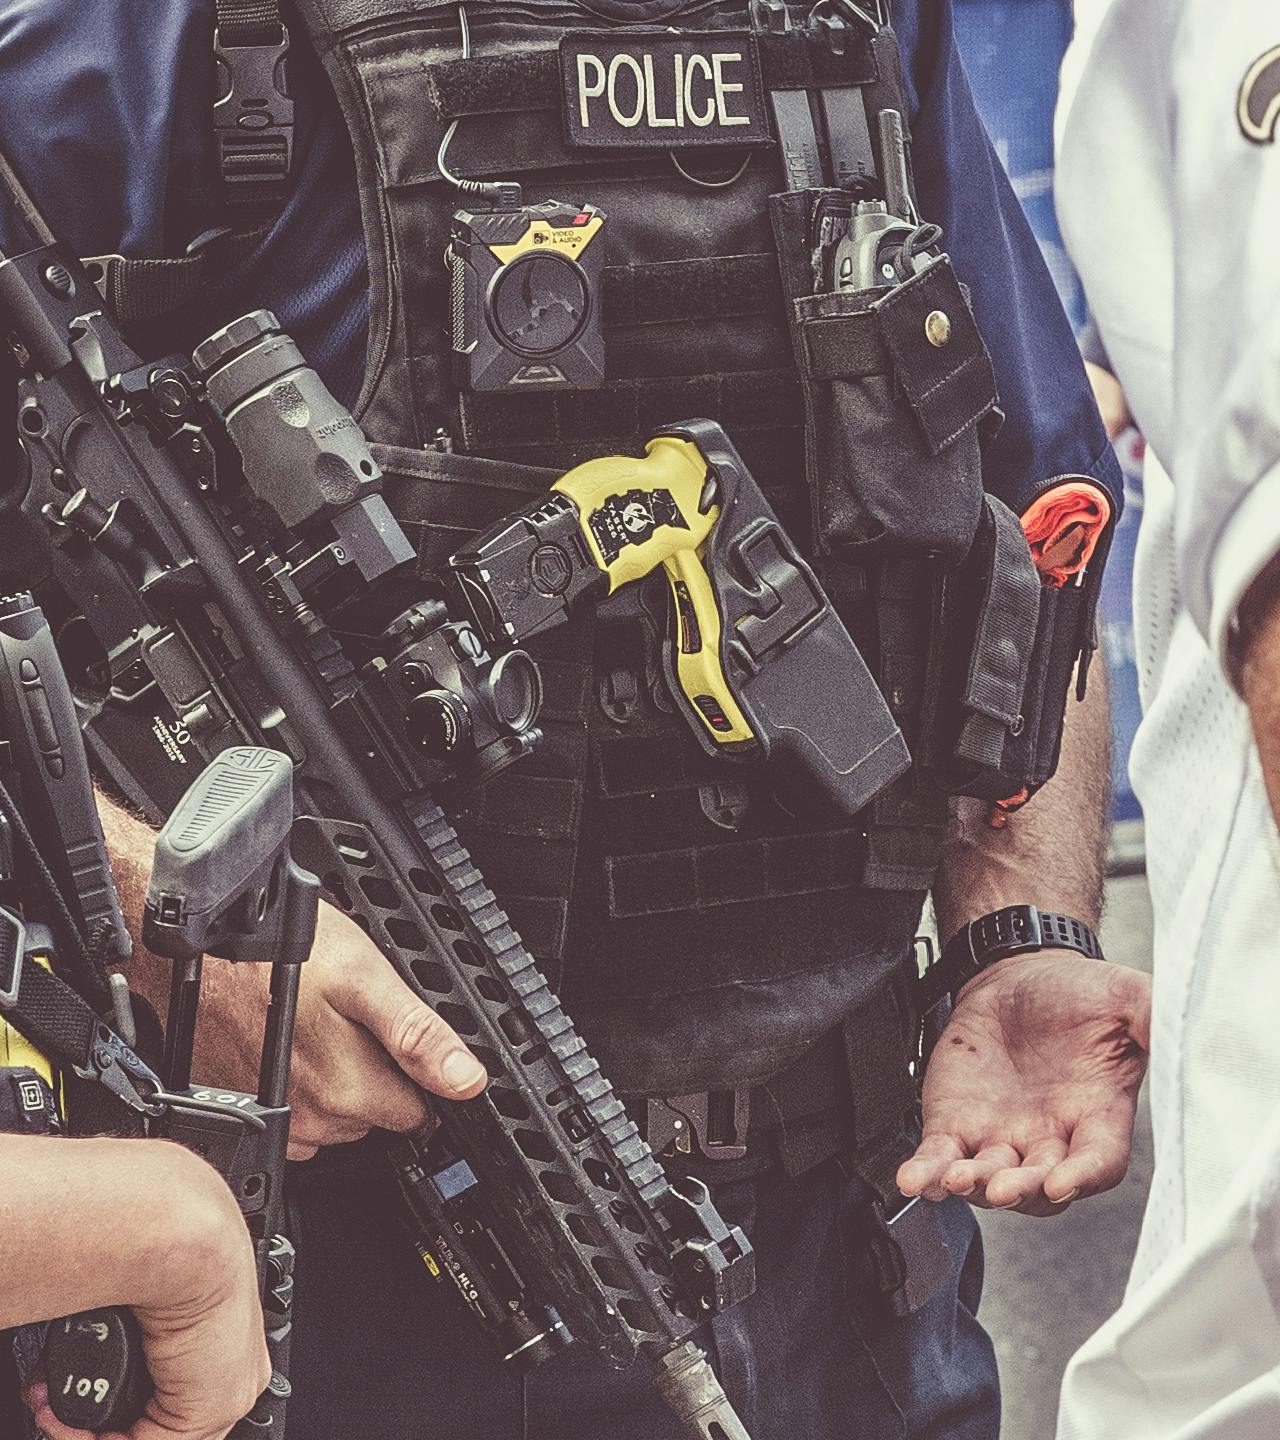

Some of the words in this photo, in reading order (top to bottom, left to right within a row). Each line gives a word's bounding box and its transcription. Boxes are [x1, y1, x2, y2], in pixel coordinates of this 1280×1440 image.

[576, 52, 750, 128] POLICE
[153, 716, 188, 764] ANNIVERSARY
[169, 720, 191, 745] 50
